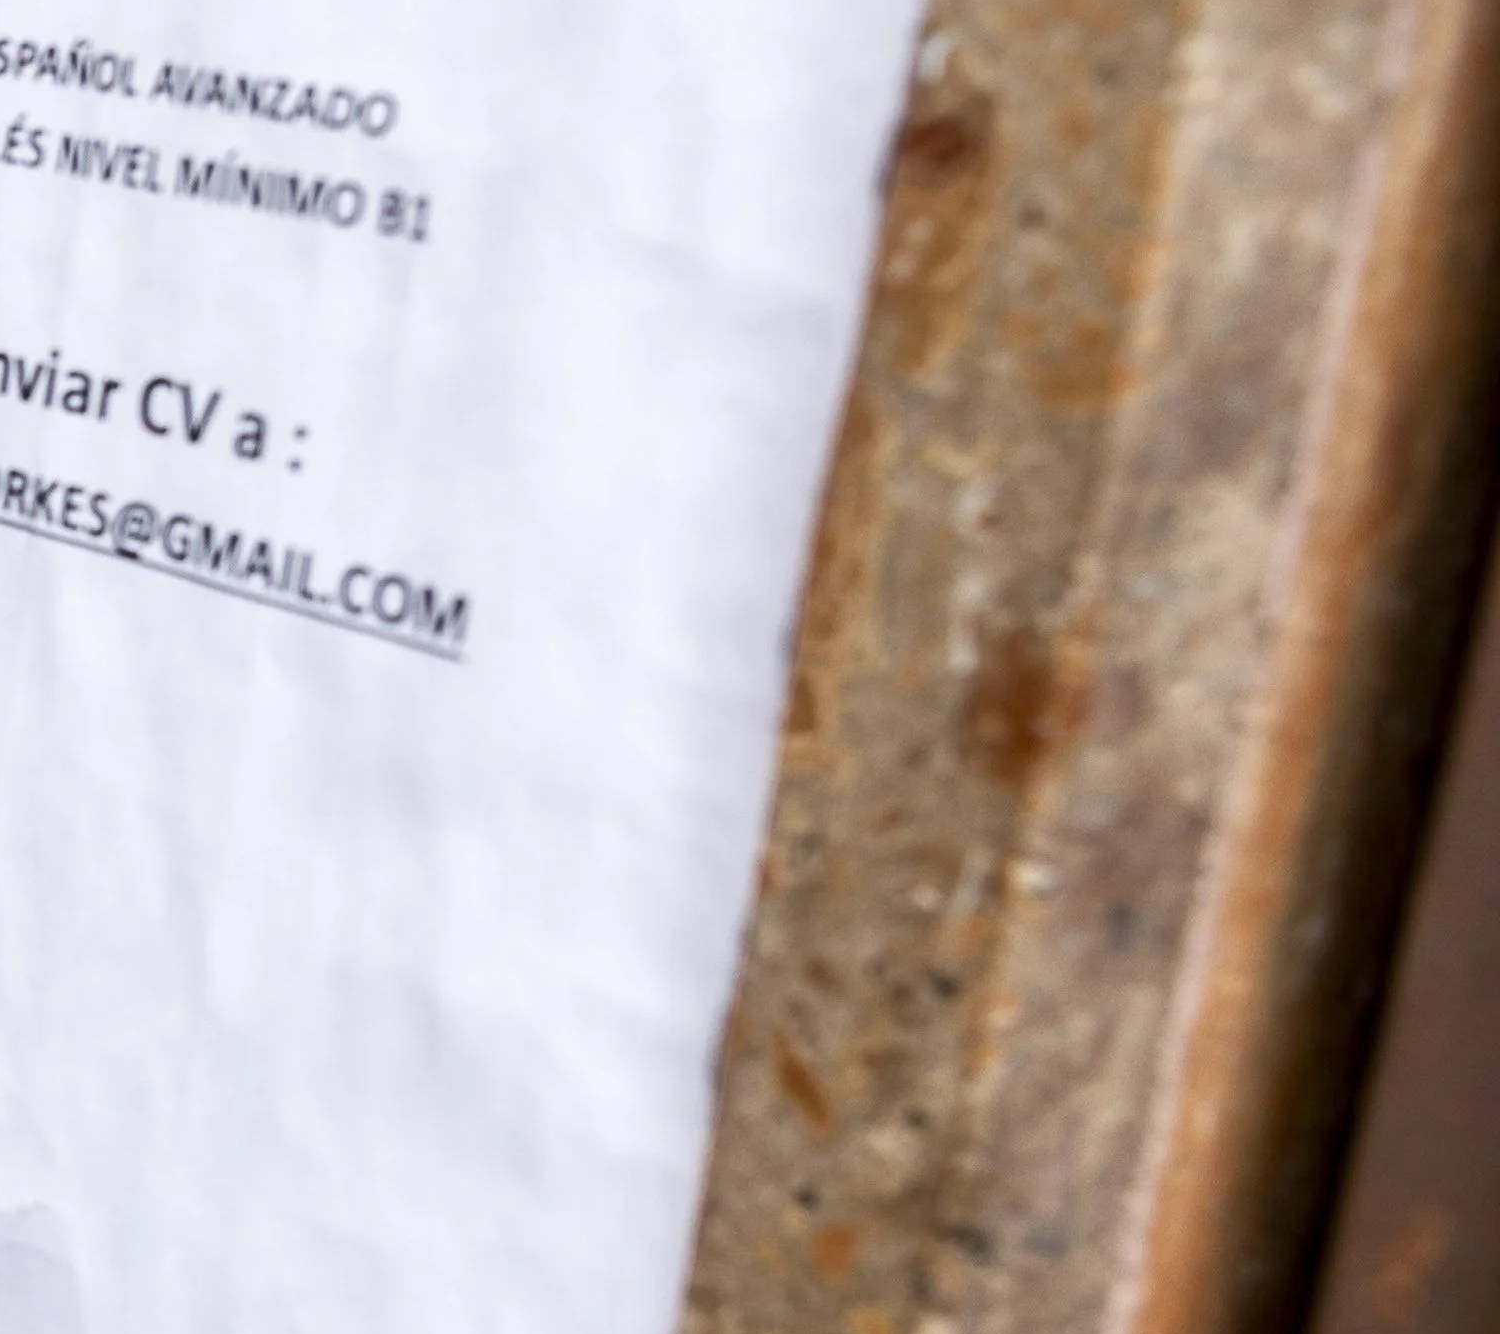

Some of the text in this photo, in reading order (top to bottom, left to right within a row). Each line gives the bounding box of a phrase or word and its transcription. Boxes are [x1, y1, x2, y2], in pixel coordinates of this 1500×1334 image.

[150, 61, 398, 138] AVANZADO
[55, 133, 163, 197] NIVEL
[174, 150, 365, 229] MÍNIMO
[137, 374, 224, 447] CV
[232, 410, 269, 463] a
